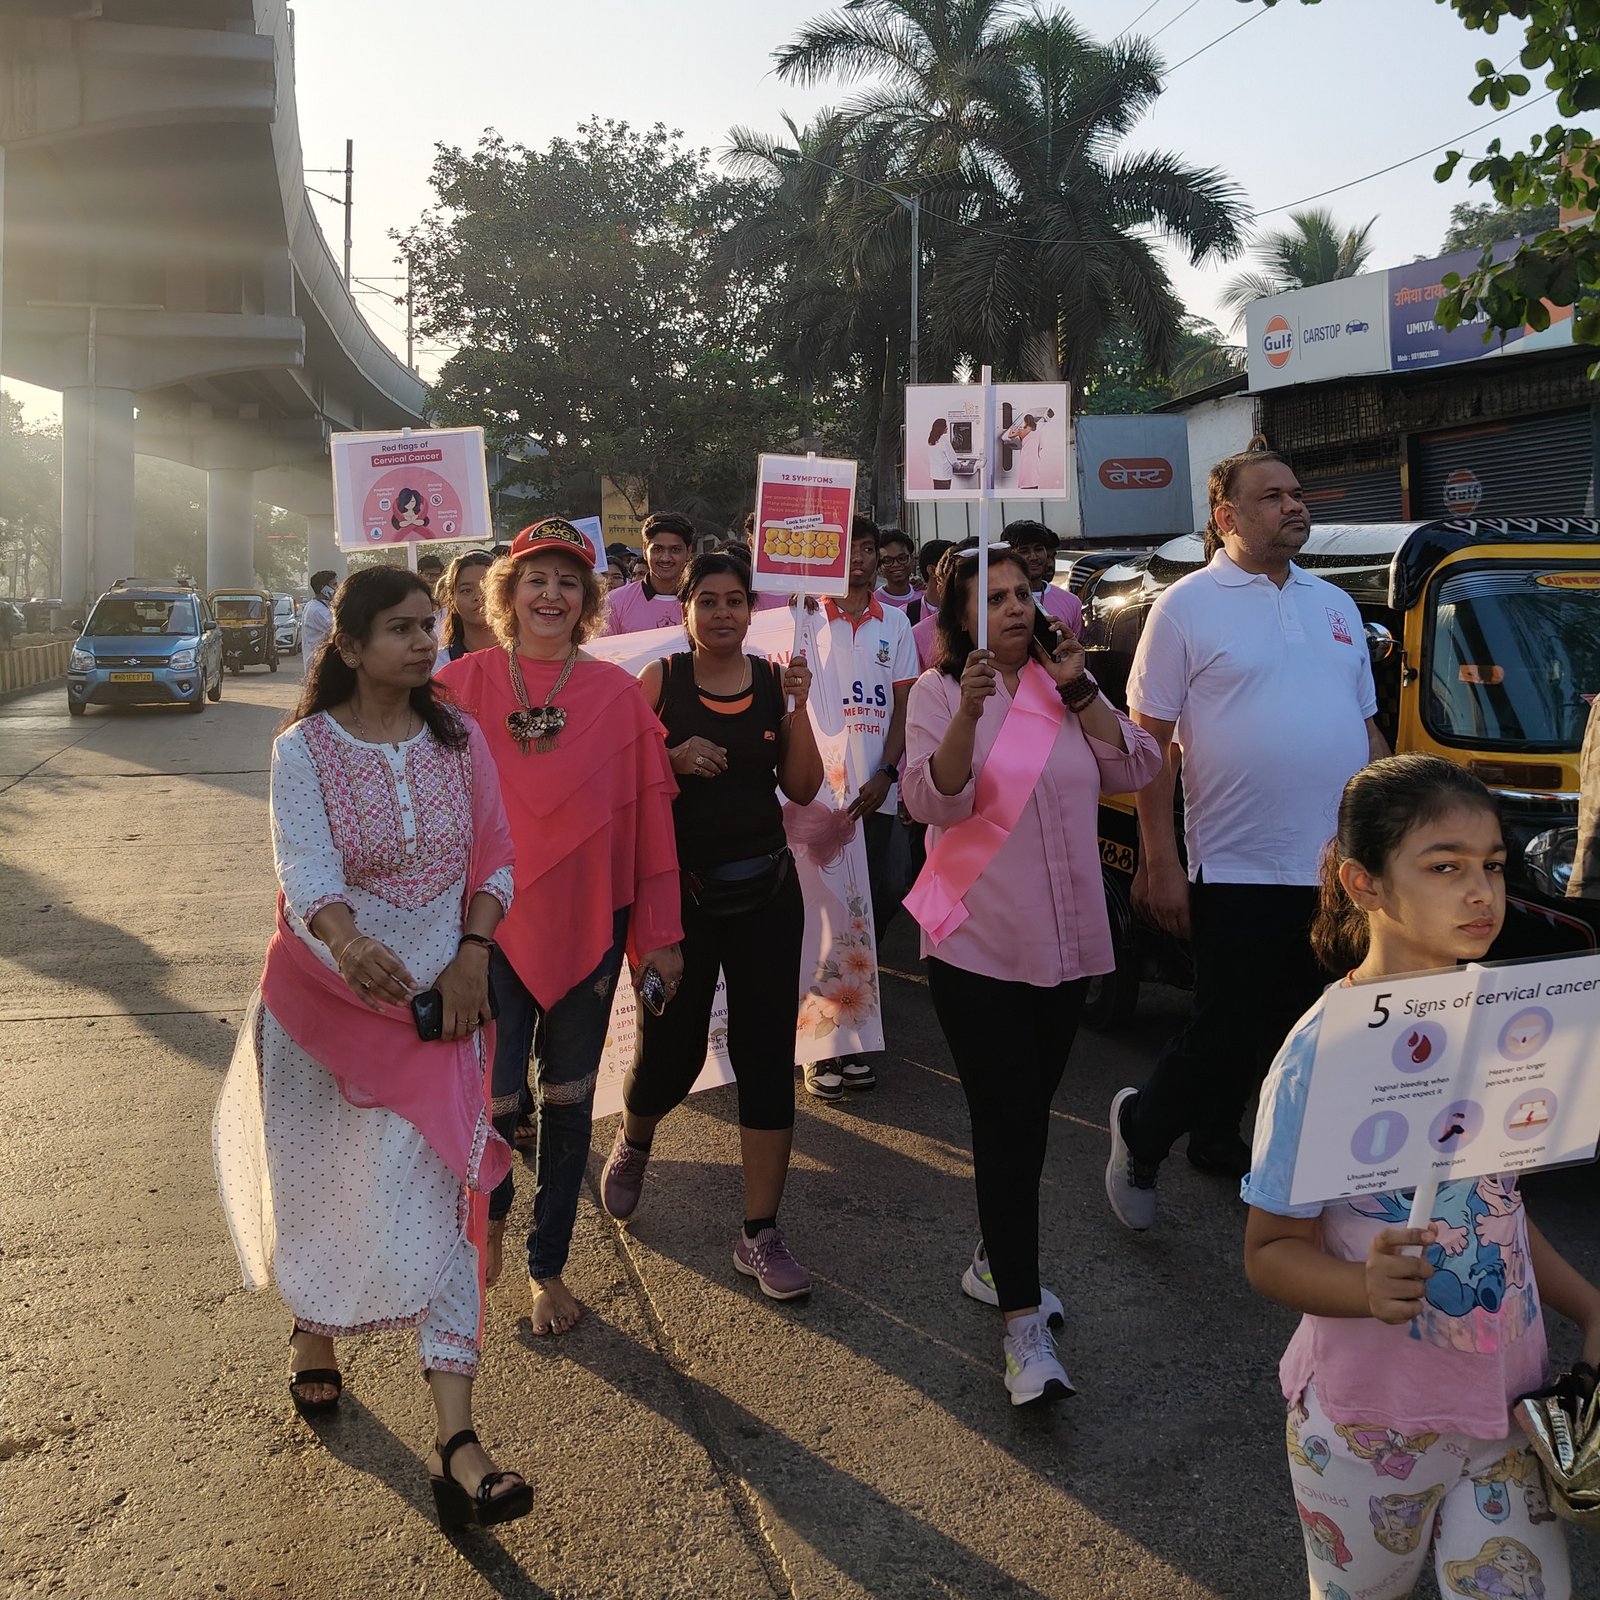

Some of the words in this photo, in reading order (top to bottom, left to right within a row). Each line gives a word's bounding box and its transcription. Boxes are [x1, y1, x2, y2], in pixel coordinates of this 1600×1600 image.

[1303, 323, 1341, 343] CARSTOP
[1406, 320, 1434, 335] UMIYA
[1263, 333, 1292, 351] Gulf
[381, 444, 396, 453] Red
[398, 442, 418, 452] flags
[420, 441, 429, 449] of
[373, 455, 407, 465] Cervical
[408, 453, 440, 462] Cancer
[792, 474, 833, 484] SYMPTOMS
[1105, 462, 1166, 485] बेस्ट
[843, 681, 886, 706] .S.S
[615, 1004, 636, 1015] 12th
[1368, 993, 1392, 1028] 5
[1403, 999, 1446, 1017] Signs
[1453, 992, 1473, 1008] of
[1476, 983, 1541, 1005] cervical
[1546, 978, 1600, 996] cancer
[617, 1018, 634, 1029] 2PM
[1374, 1082, 1398, 1092] Vaginal
[1400, 1079, 1428, 1088] bleeding
[1371, 1097, 1385, 1105] you
[1398, 1092, 1410, 1100] not
[1412, 1089, 1435, 1098] expect
[1346, 1170, 1375, 1181] Unusual
[1377, 1167, 1399, 1178] vaginal
[1355, 1180, 1388, 1191] discharge
